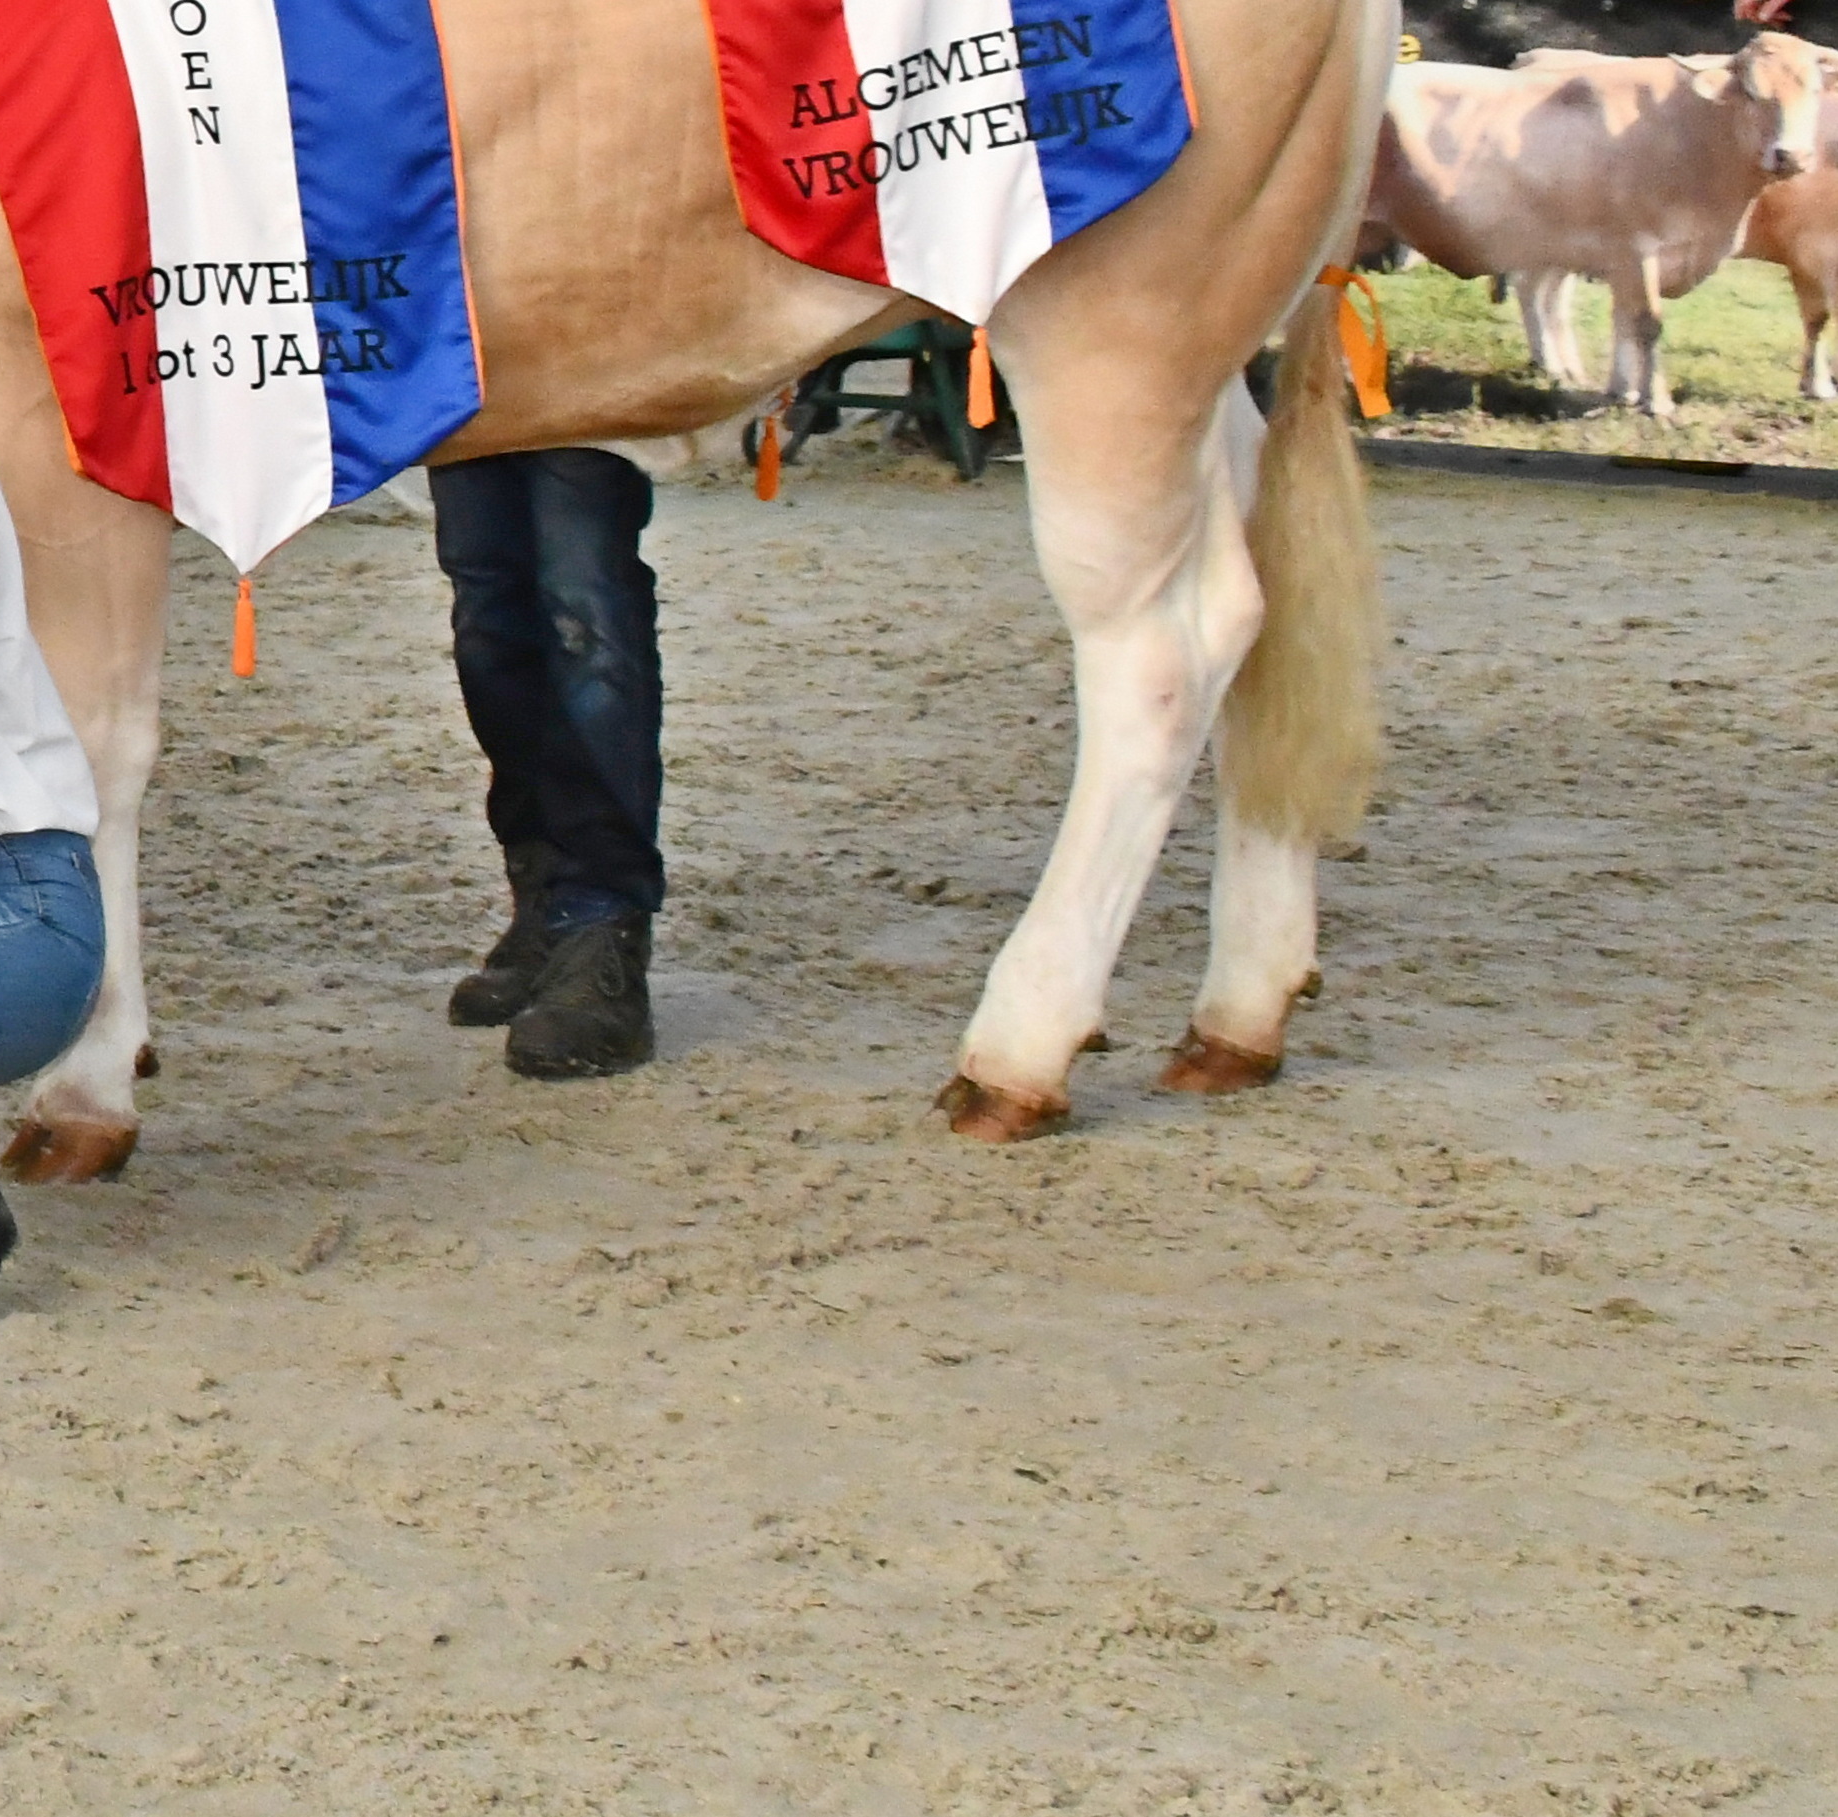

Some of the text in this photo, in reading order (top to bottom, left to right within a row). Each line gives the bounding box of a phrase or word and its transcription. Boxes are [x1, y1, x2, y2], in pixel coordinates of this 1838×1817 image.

[790, 14, 1094, 129] ALGEMEEN
[783, 82, 1133, 199] VROUWELIJK
[89, 252, 410, 327] VROUWELIJK
[212, 334, 235, 377] 3
[250, 328, 394, 389] JAAR
